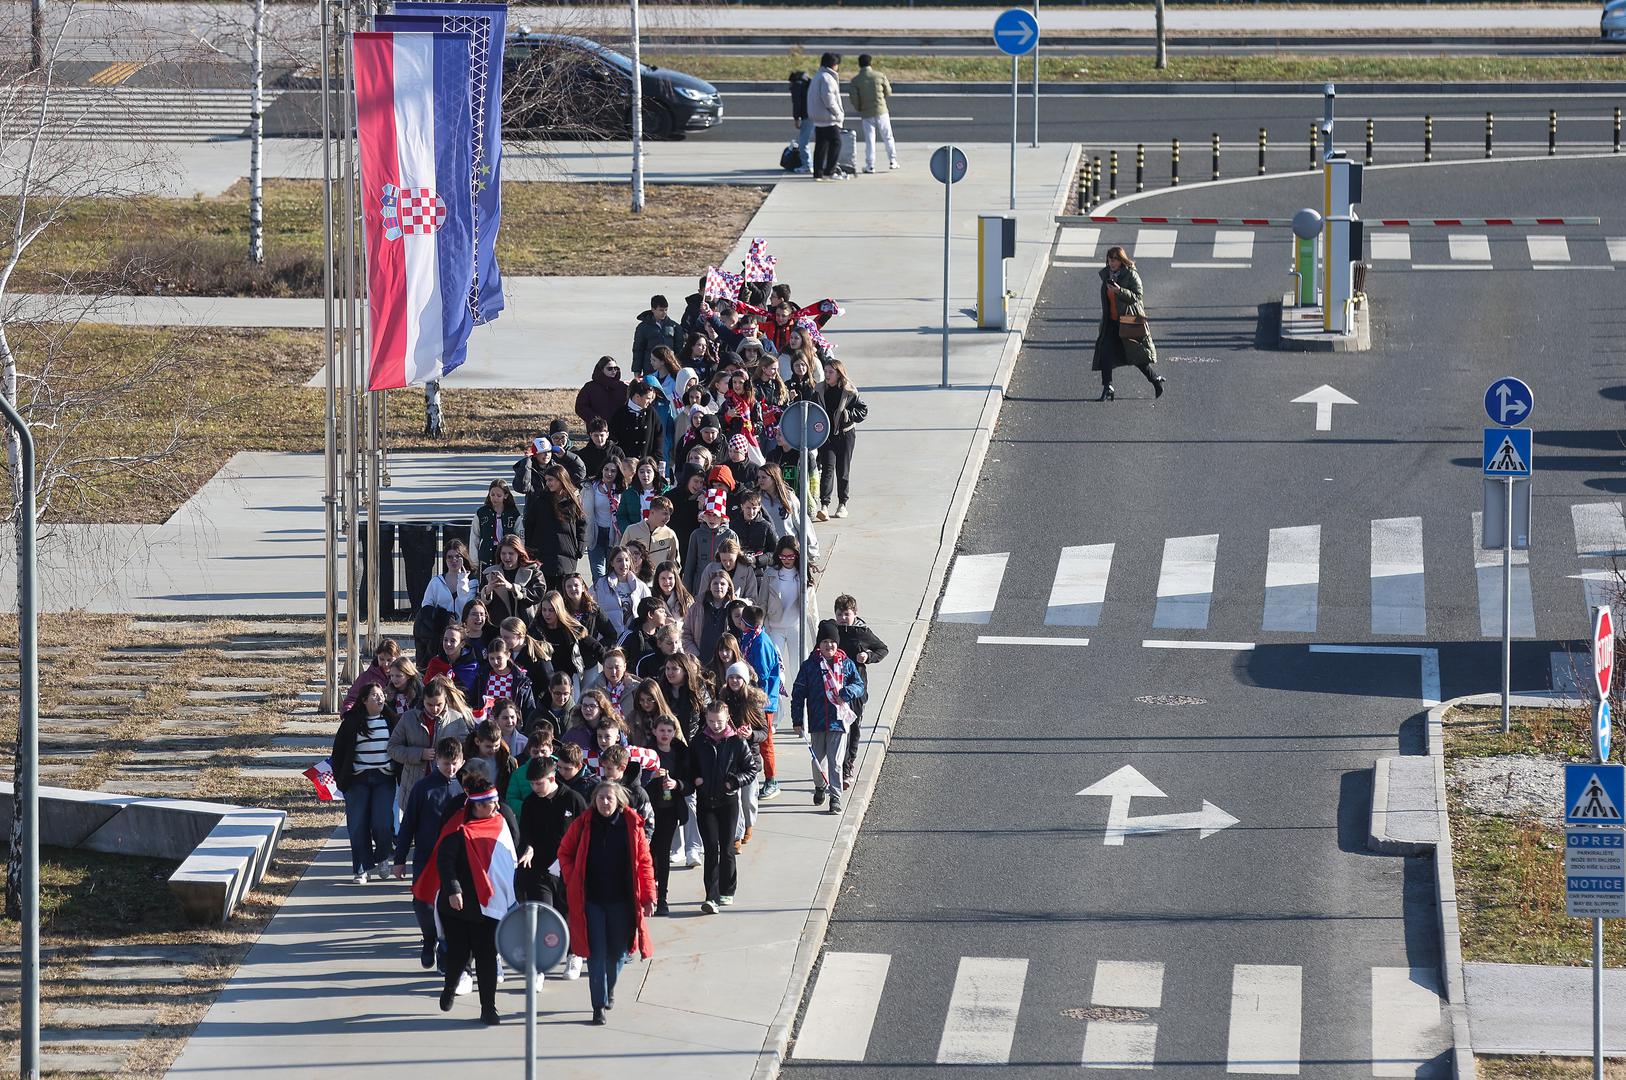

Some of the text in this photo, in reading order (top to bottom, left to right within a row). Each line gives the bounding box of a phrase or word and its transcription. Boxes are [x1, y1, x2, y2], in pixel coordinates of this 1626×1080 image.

[1597, 634, 1613, 674] STOP
[1569, 836, 1621, 846] OPREZ
[1570, 879, 1622, 889] NOTICE
